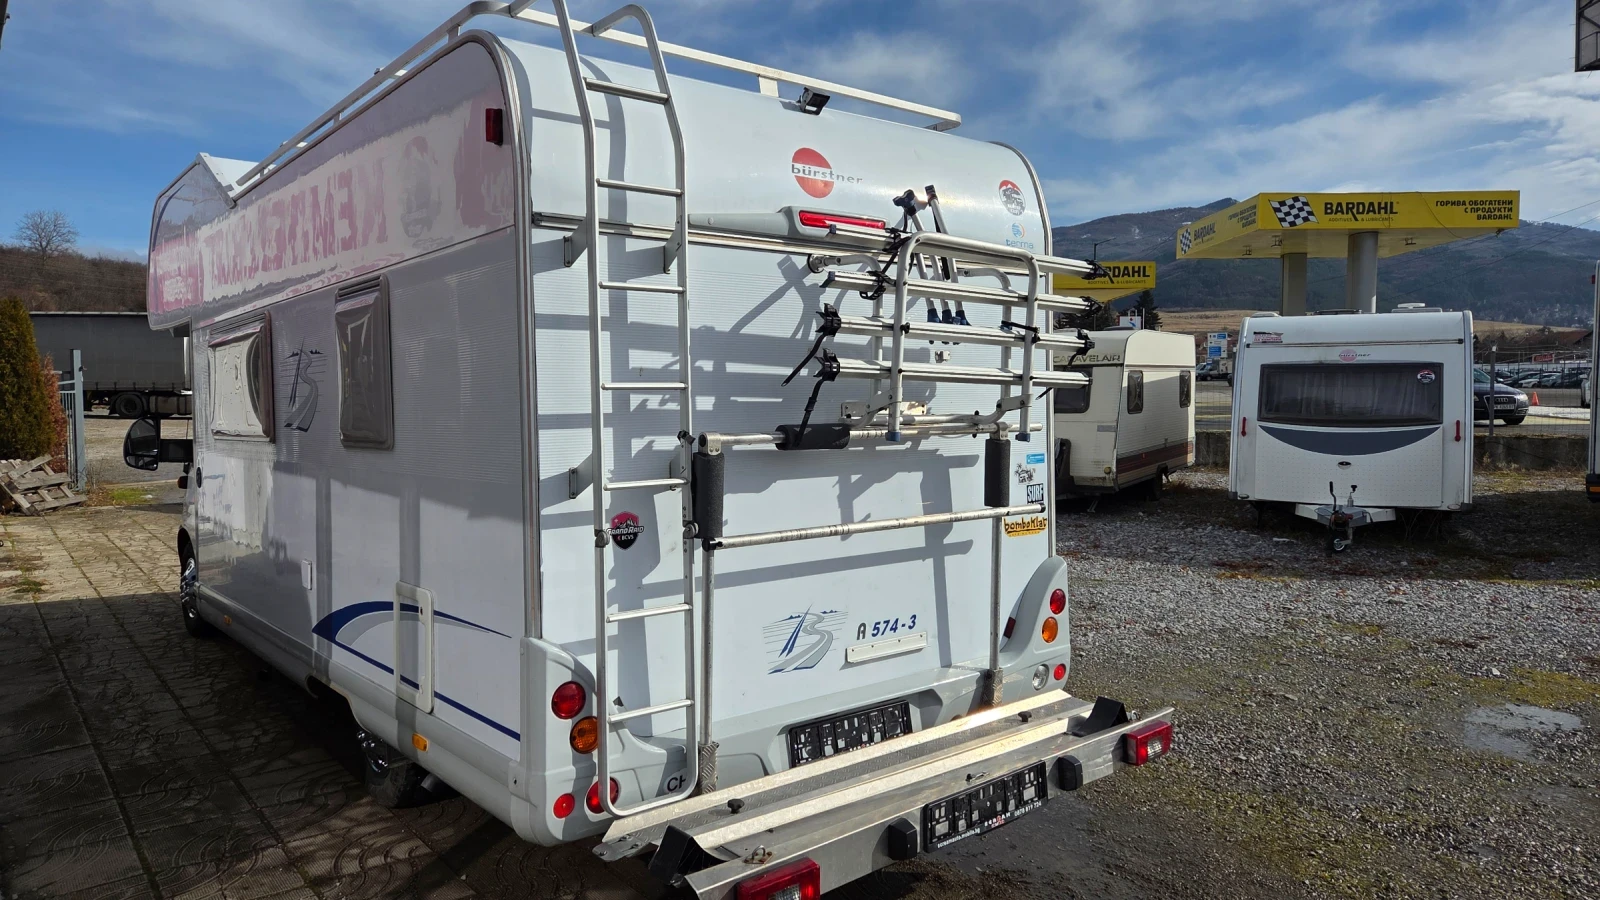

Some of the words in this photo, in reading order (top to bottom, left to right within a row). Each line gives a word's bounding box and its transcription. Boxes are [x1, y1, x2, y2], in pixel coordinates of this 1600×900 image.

[791, 164, 863, 184] bürstner
[1324, 201, 1398, 221] BARDAHL
[1470, 206, 1513, 214] ПРОДУКТИ
[1476, 213, 1513, 221] BARDAHL
[1027, 485, 1044, 502] SURF
[857, 622, 867, 640] A
[871, 614, 917, 637] 574-3
